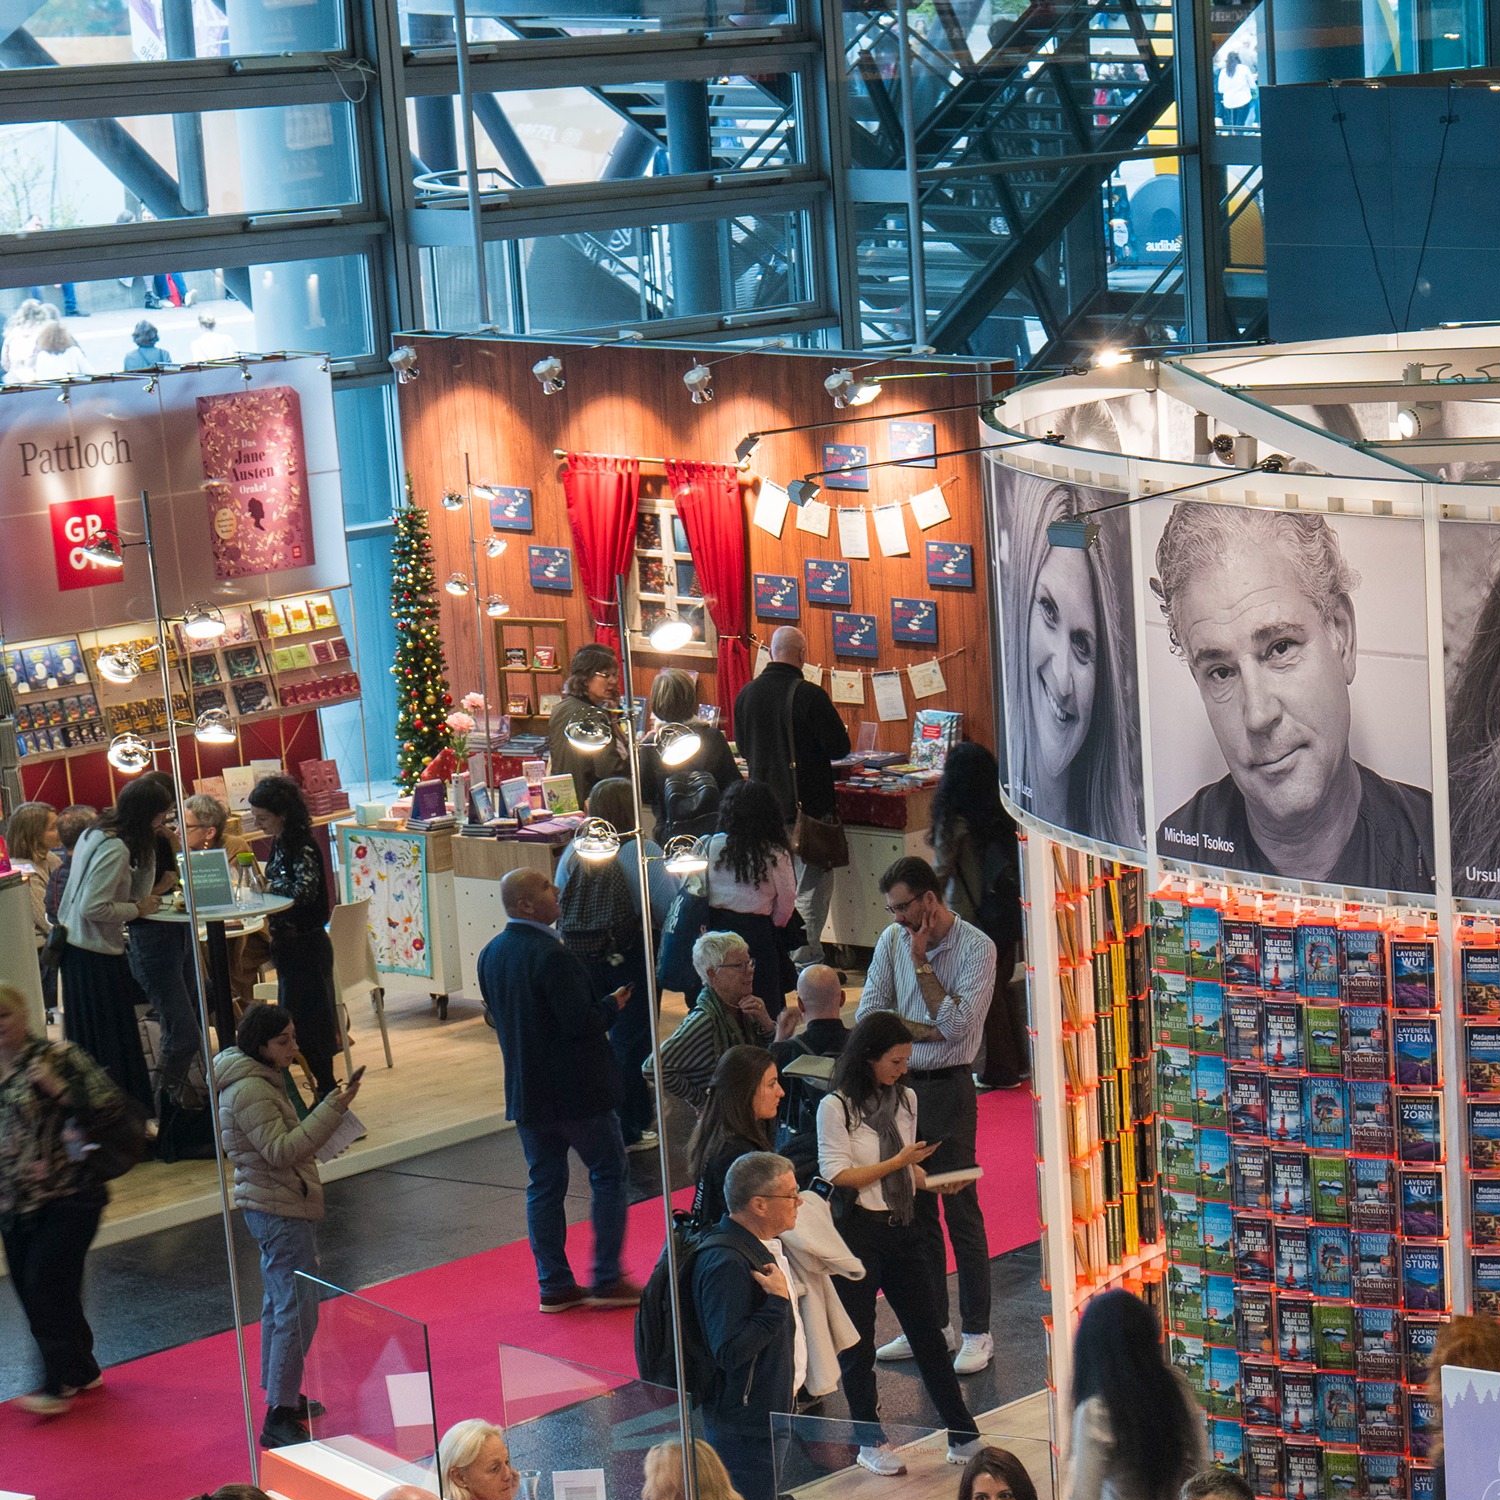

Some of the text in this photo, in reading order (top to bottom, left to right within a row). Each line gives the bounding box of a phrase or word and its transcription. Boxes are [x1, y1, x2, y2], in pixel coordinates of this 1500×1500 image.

[1146, 239, 1181, 252] audible
[241, 439, 257, 448] Das
[18, 430, 134, 477] Pattloch
[234, 450, 266, 465] Jane
[231, 466, 275, 482] Austen
[239, 482, 267, 495] Orakel
[1021, 780, 1033, 799] Lucas
[1164, 826, 1235, 854] Michael Tsokos
[1401, 957, 1425, 966] WUT
[1397, 1034, 1434, 1043] STURM
[1403, 1110, 1432, 1119] ZORN
